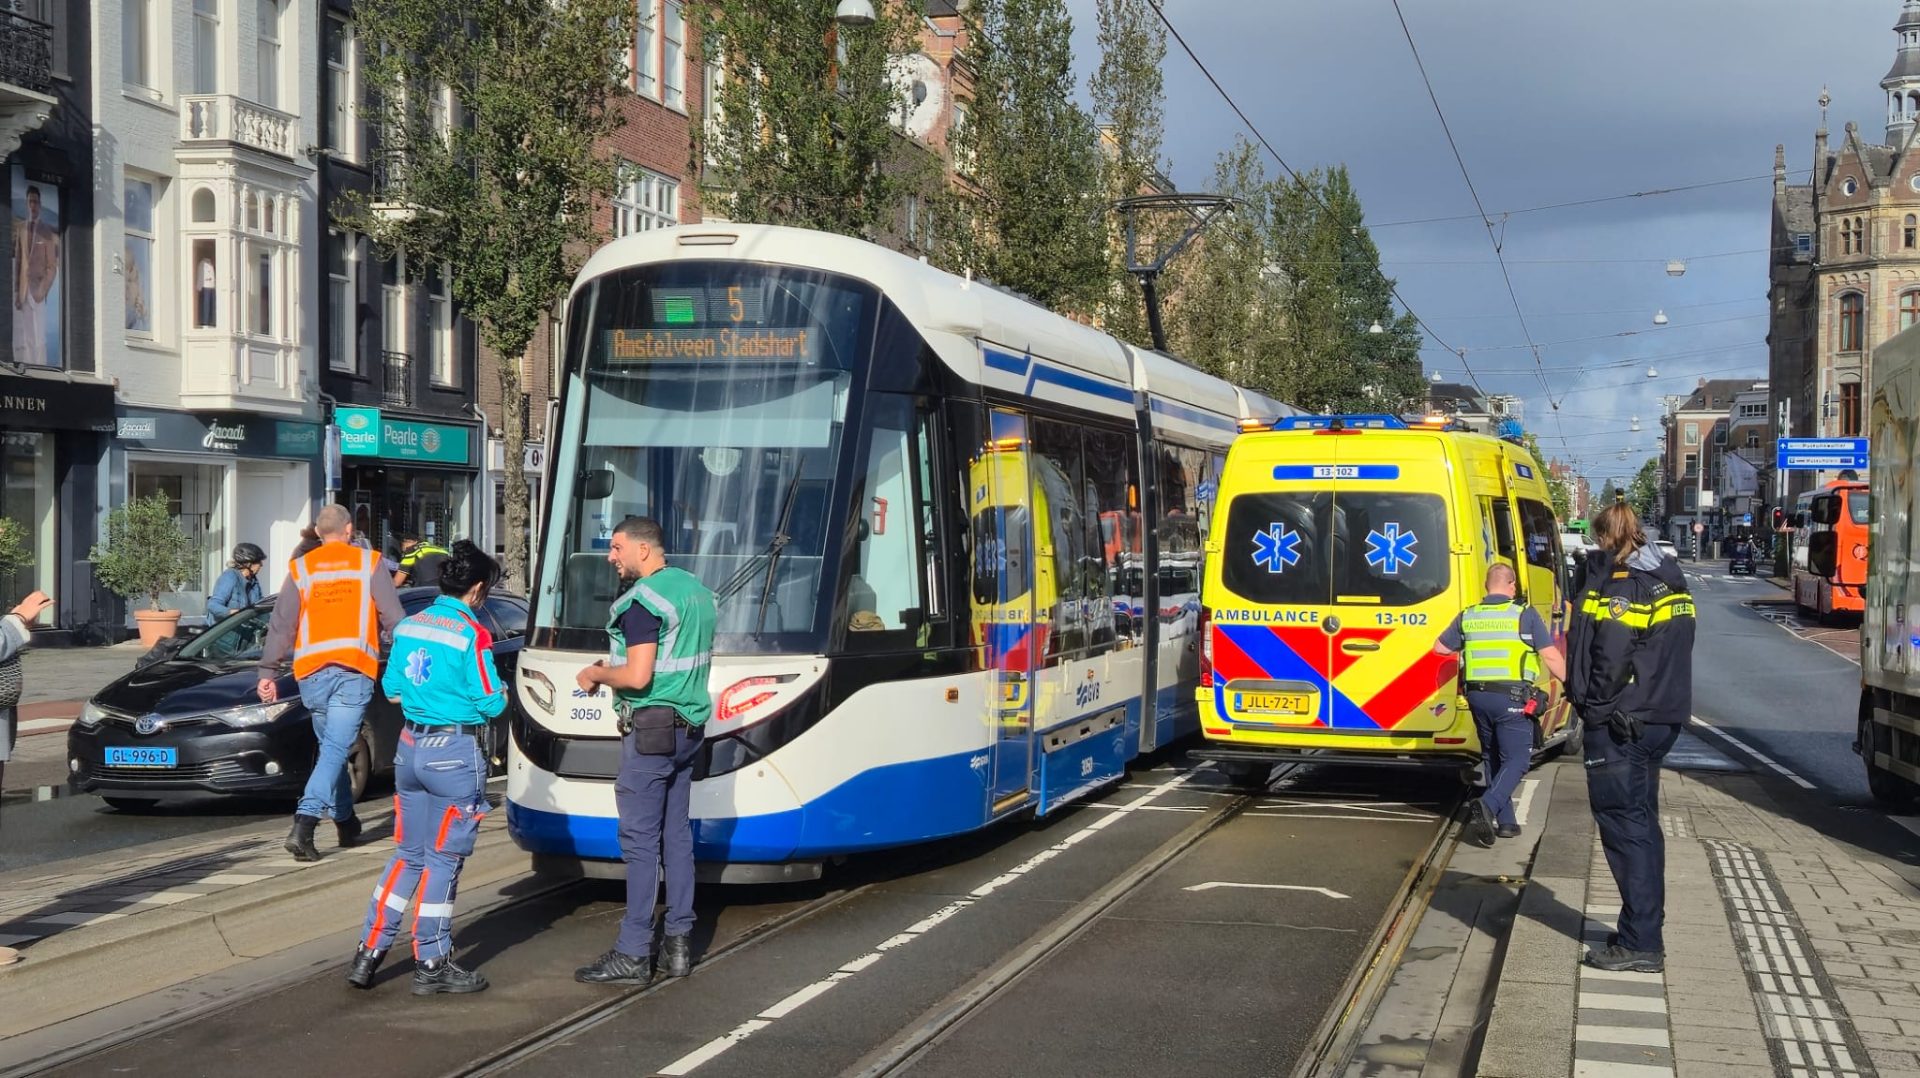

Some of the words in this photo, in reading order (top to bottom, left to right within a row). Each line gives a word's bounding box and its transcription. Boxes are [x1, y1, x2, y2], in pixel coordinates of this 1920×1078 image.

[726, 286, 745, 322] 5
[613, 329, 715, 359] Amstelveen
[719, 327, 809, 358] Stadshart
[383, 424, 418, 446] Pearle
[1214, 609, 1319, 623] AMBULANCE
[1375, 612, 1427, 626] 13-102
[1247, 696, 1302, 709] JLL-72-T
[570, 708, 602, 721] 3050
[111, 749, 169, 763] GL-996-D
